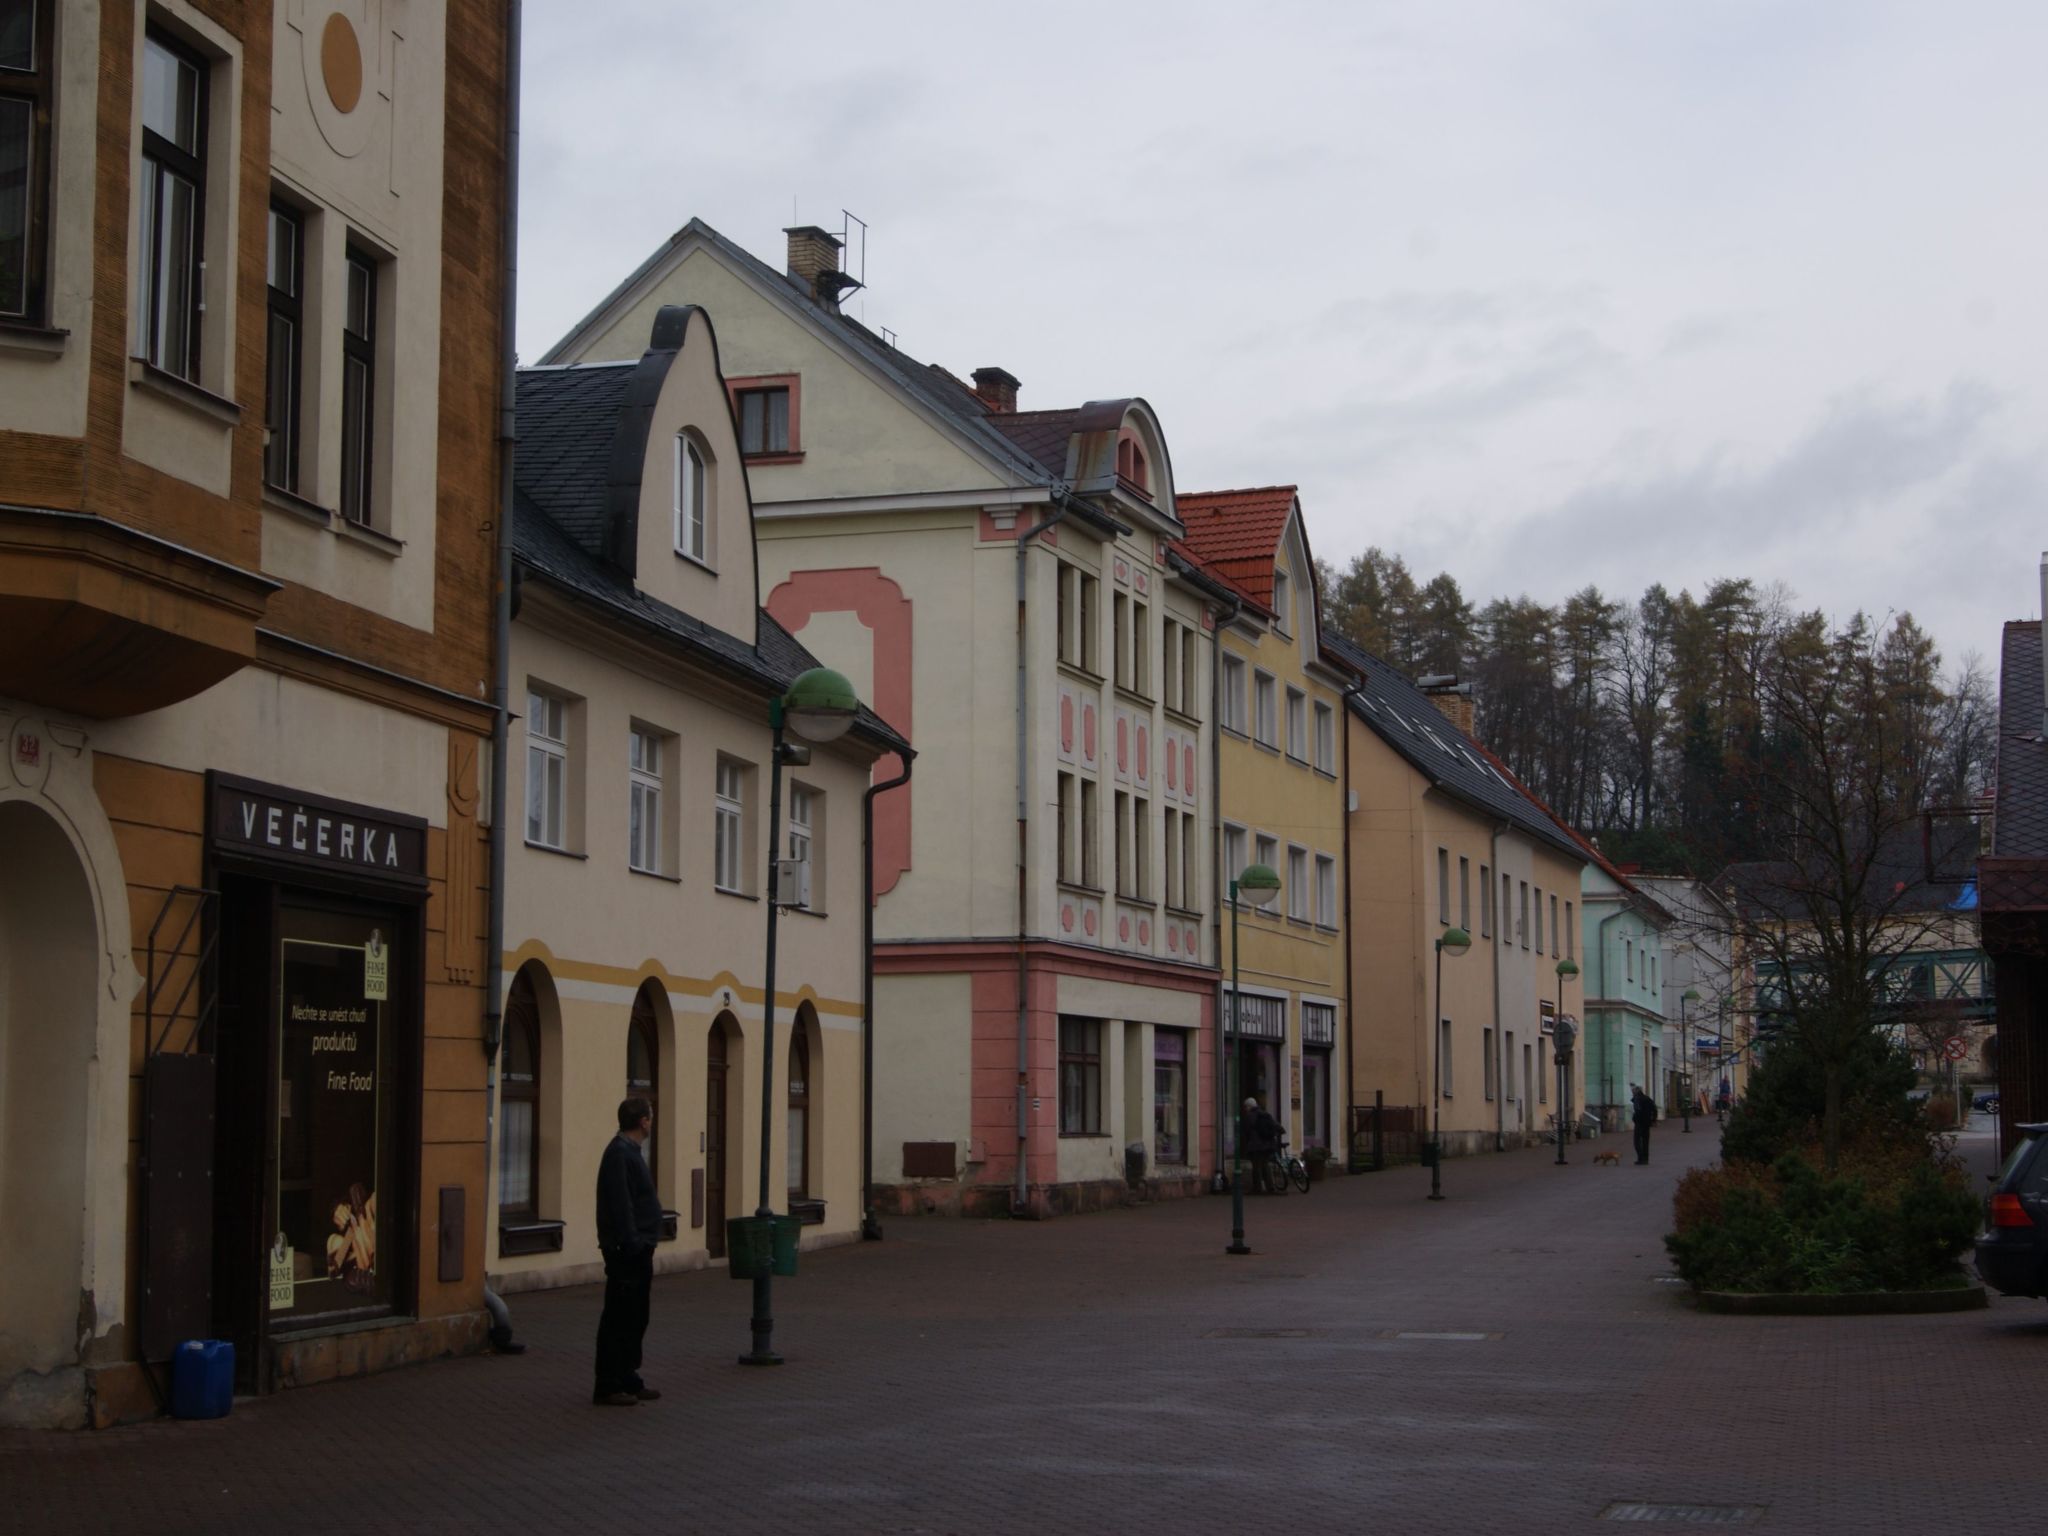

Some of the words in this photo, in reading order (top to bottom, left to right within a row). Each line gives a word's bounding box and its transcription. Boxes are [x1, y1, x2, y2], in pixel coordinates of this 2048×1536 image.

[242, 801, 398, 867] VEČERKA
[367, 961, 385, 975] FINE
[367, 980, 385, 992] FOOD
[292, 1004, 318, 1021] Nechte
[319, 1009, 328, 1021] se
[328, 1007, 348, 1022] unést
[349, 1008, 368, 1023] chutí
[312, 1031, 358, 1056] produktů
[328, 1070, 347, 1090] Fine
[350, 1070, 373, 1091] Food
[270, 1267, 291, 1282] FINE
[270, 1287, 291, 1301] FOOD
